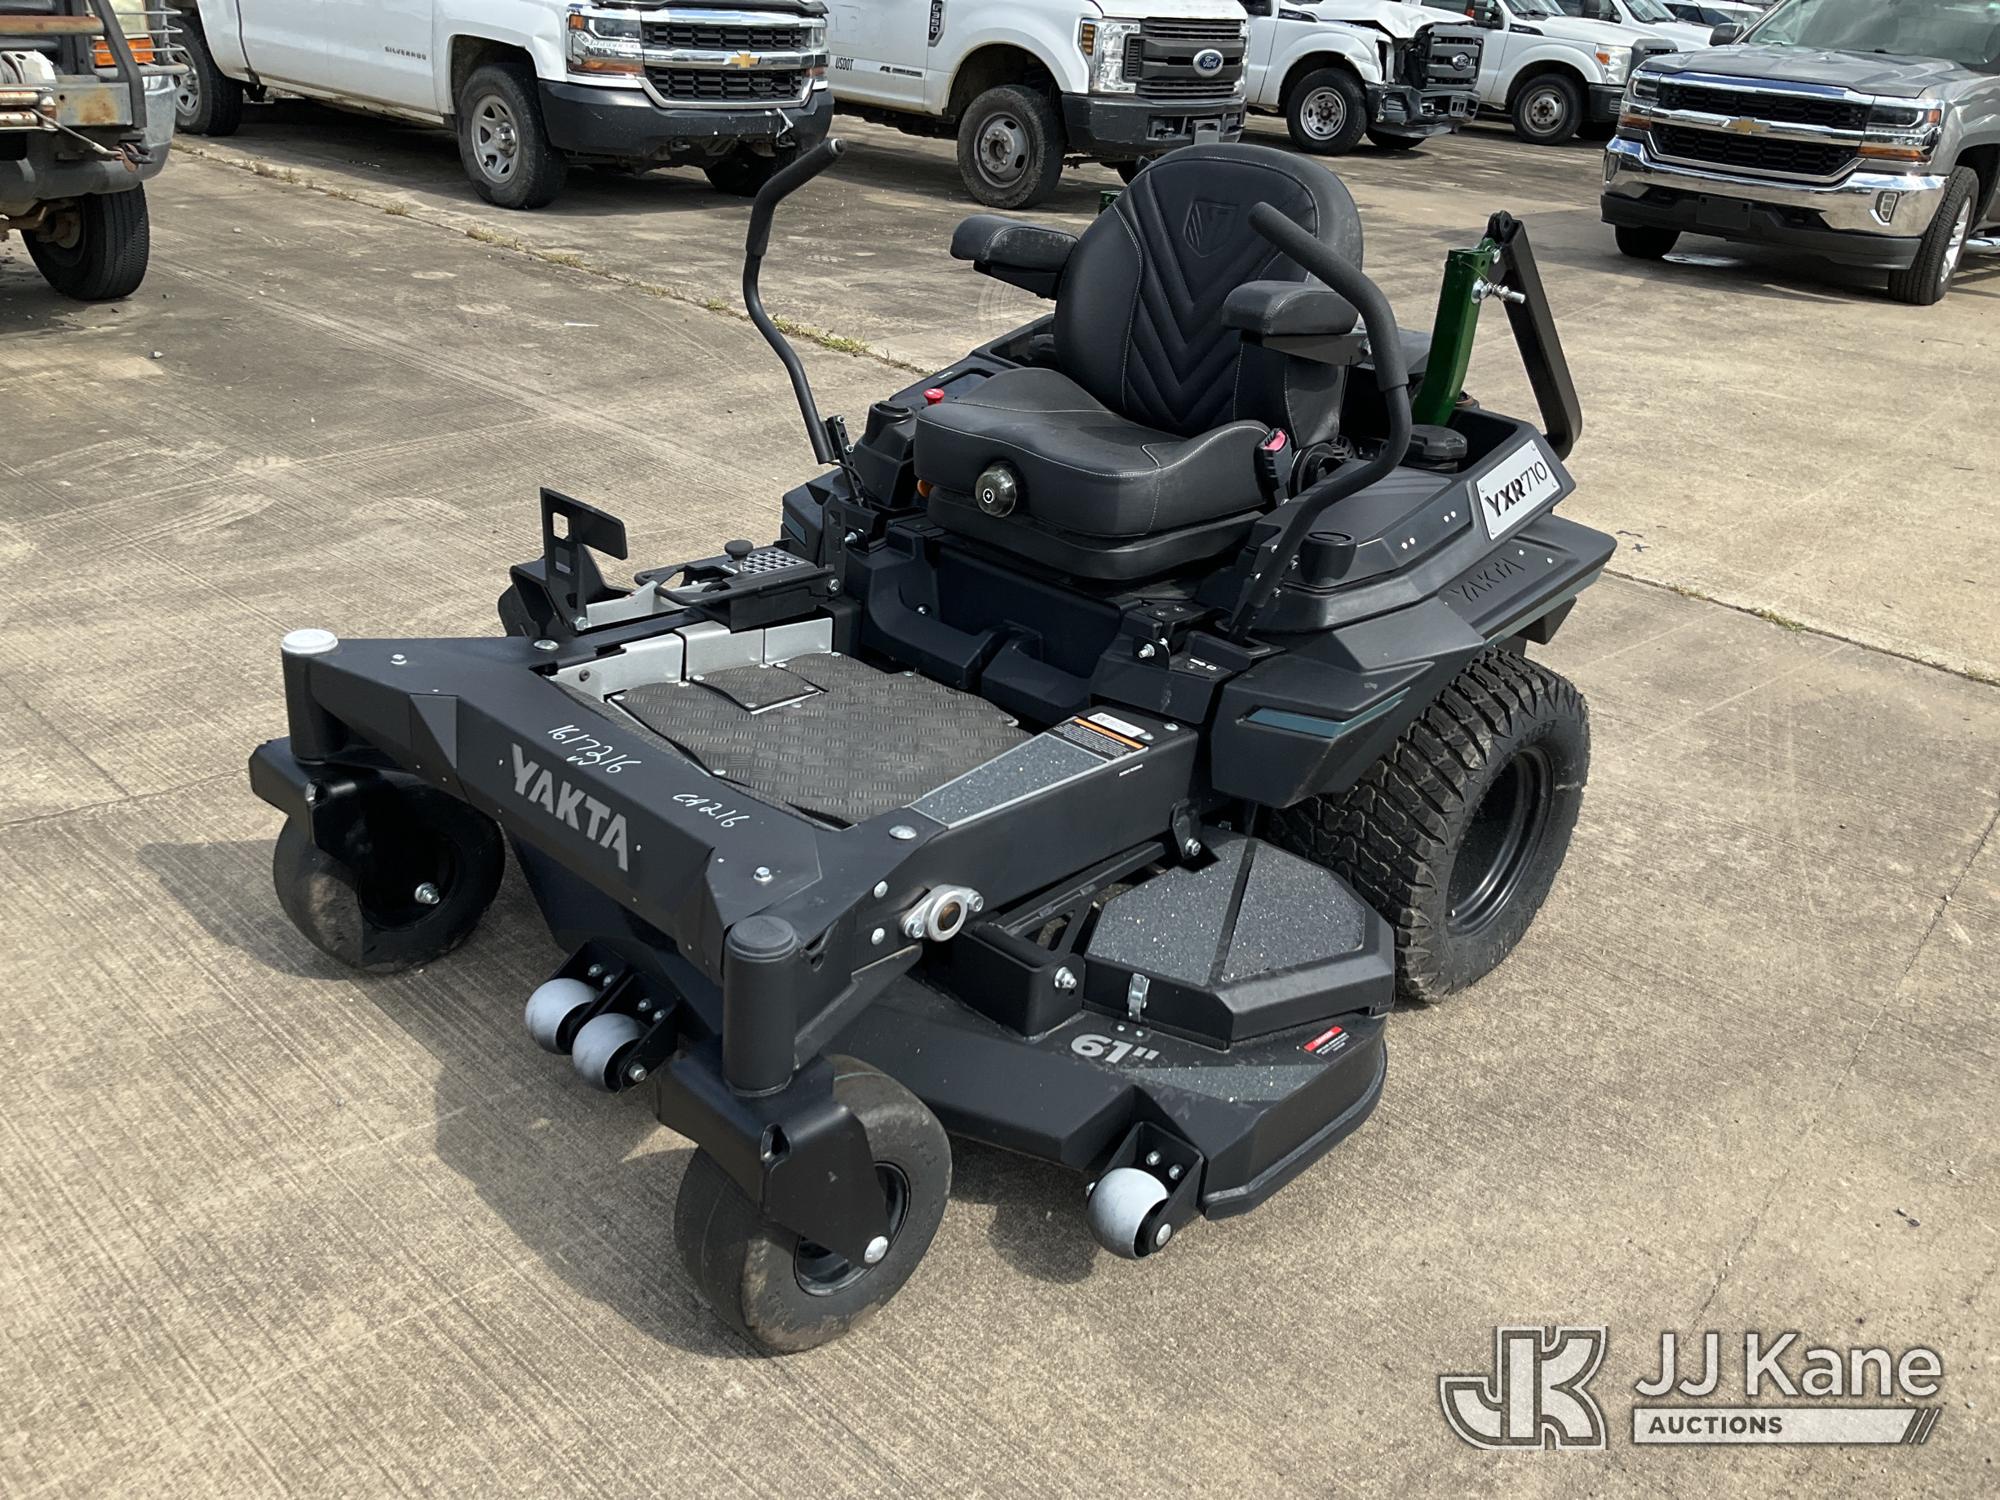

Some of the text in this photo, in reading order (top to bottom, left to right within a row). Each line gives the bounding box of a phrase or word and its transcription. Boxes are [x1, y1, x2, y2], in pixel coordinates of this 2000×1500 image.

[835, 57, 854, 71] USDOT
[1484, 461, 1548, 518] YXR710
[511, 742, 630, 873] YAKTA
[1070, 1033, 1160, 1064] 61"
